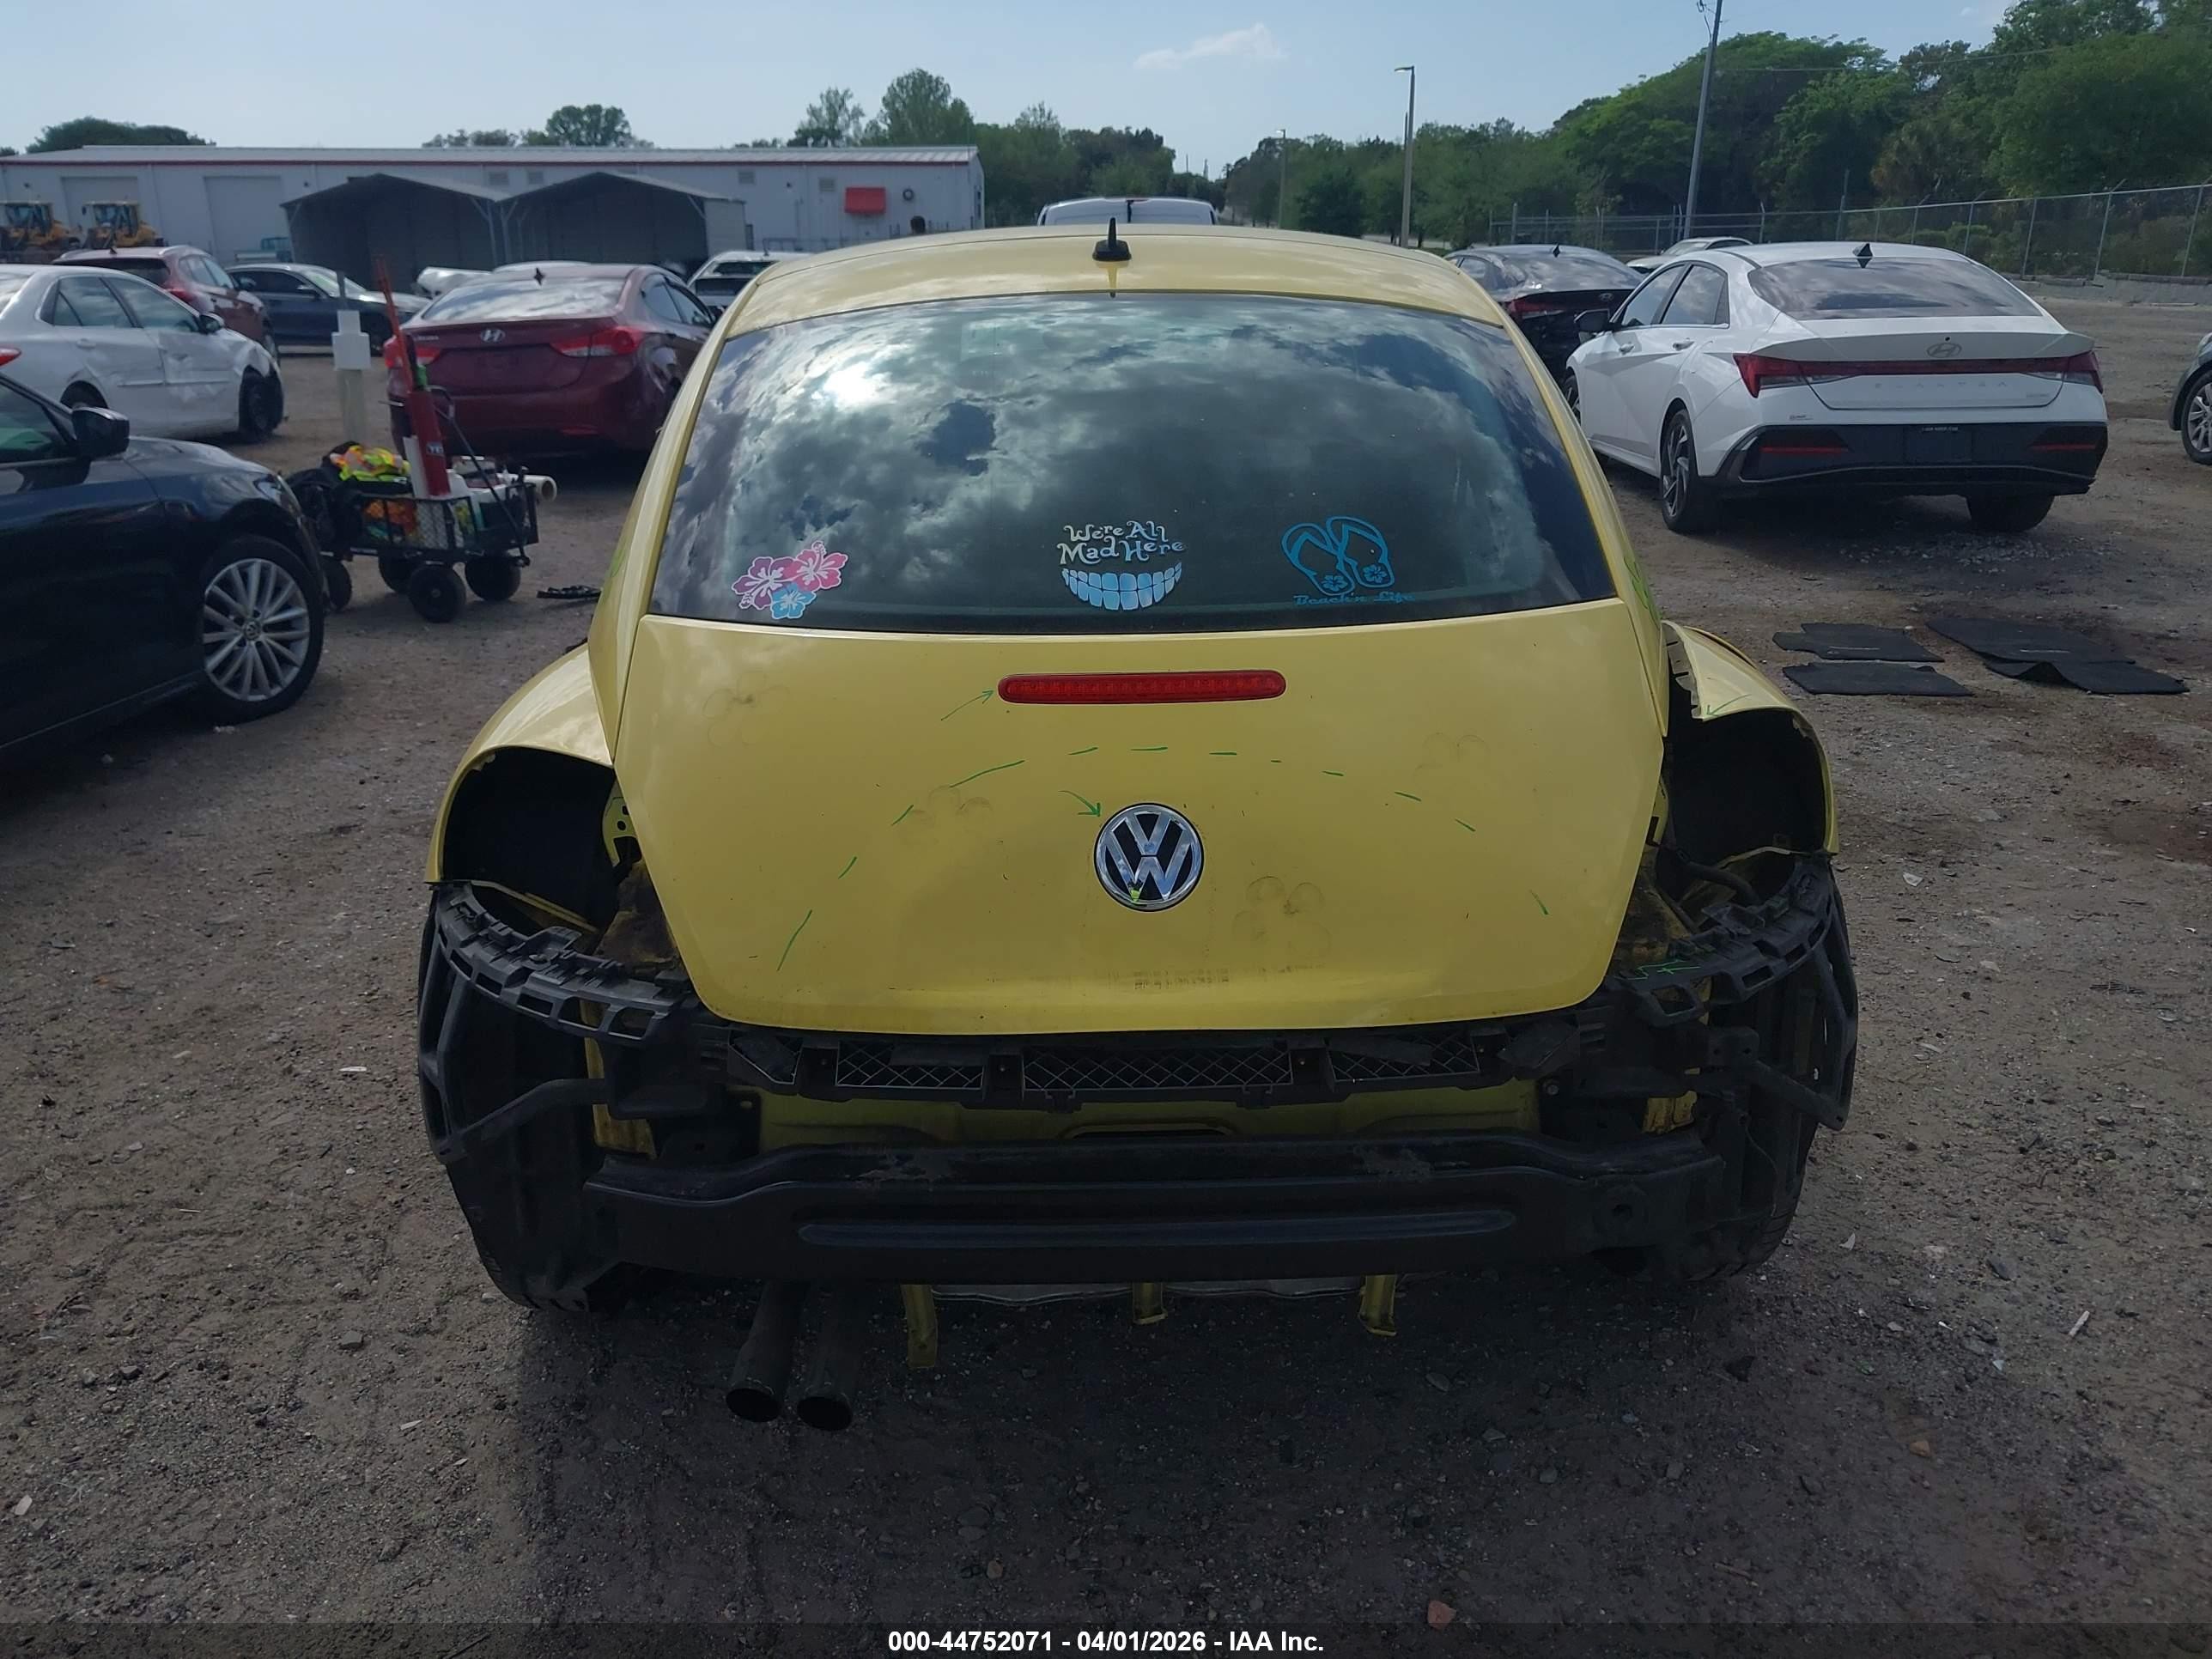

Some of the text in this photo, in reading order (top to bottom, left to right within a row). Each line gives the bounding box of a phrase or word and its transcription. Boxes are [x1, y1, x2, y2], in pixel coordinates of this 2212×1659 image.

[1063, 520, 1169, 542] We're All
[1057, 536, 1185, 564] Mad Here
[1099, 805, 1200, 908] VW
